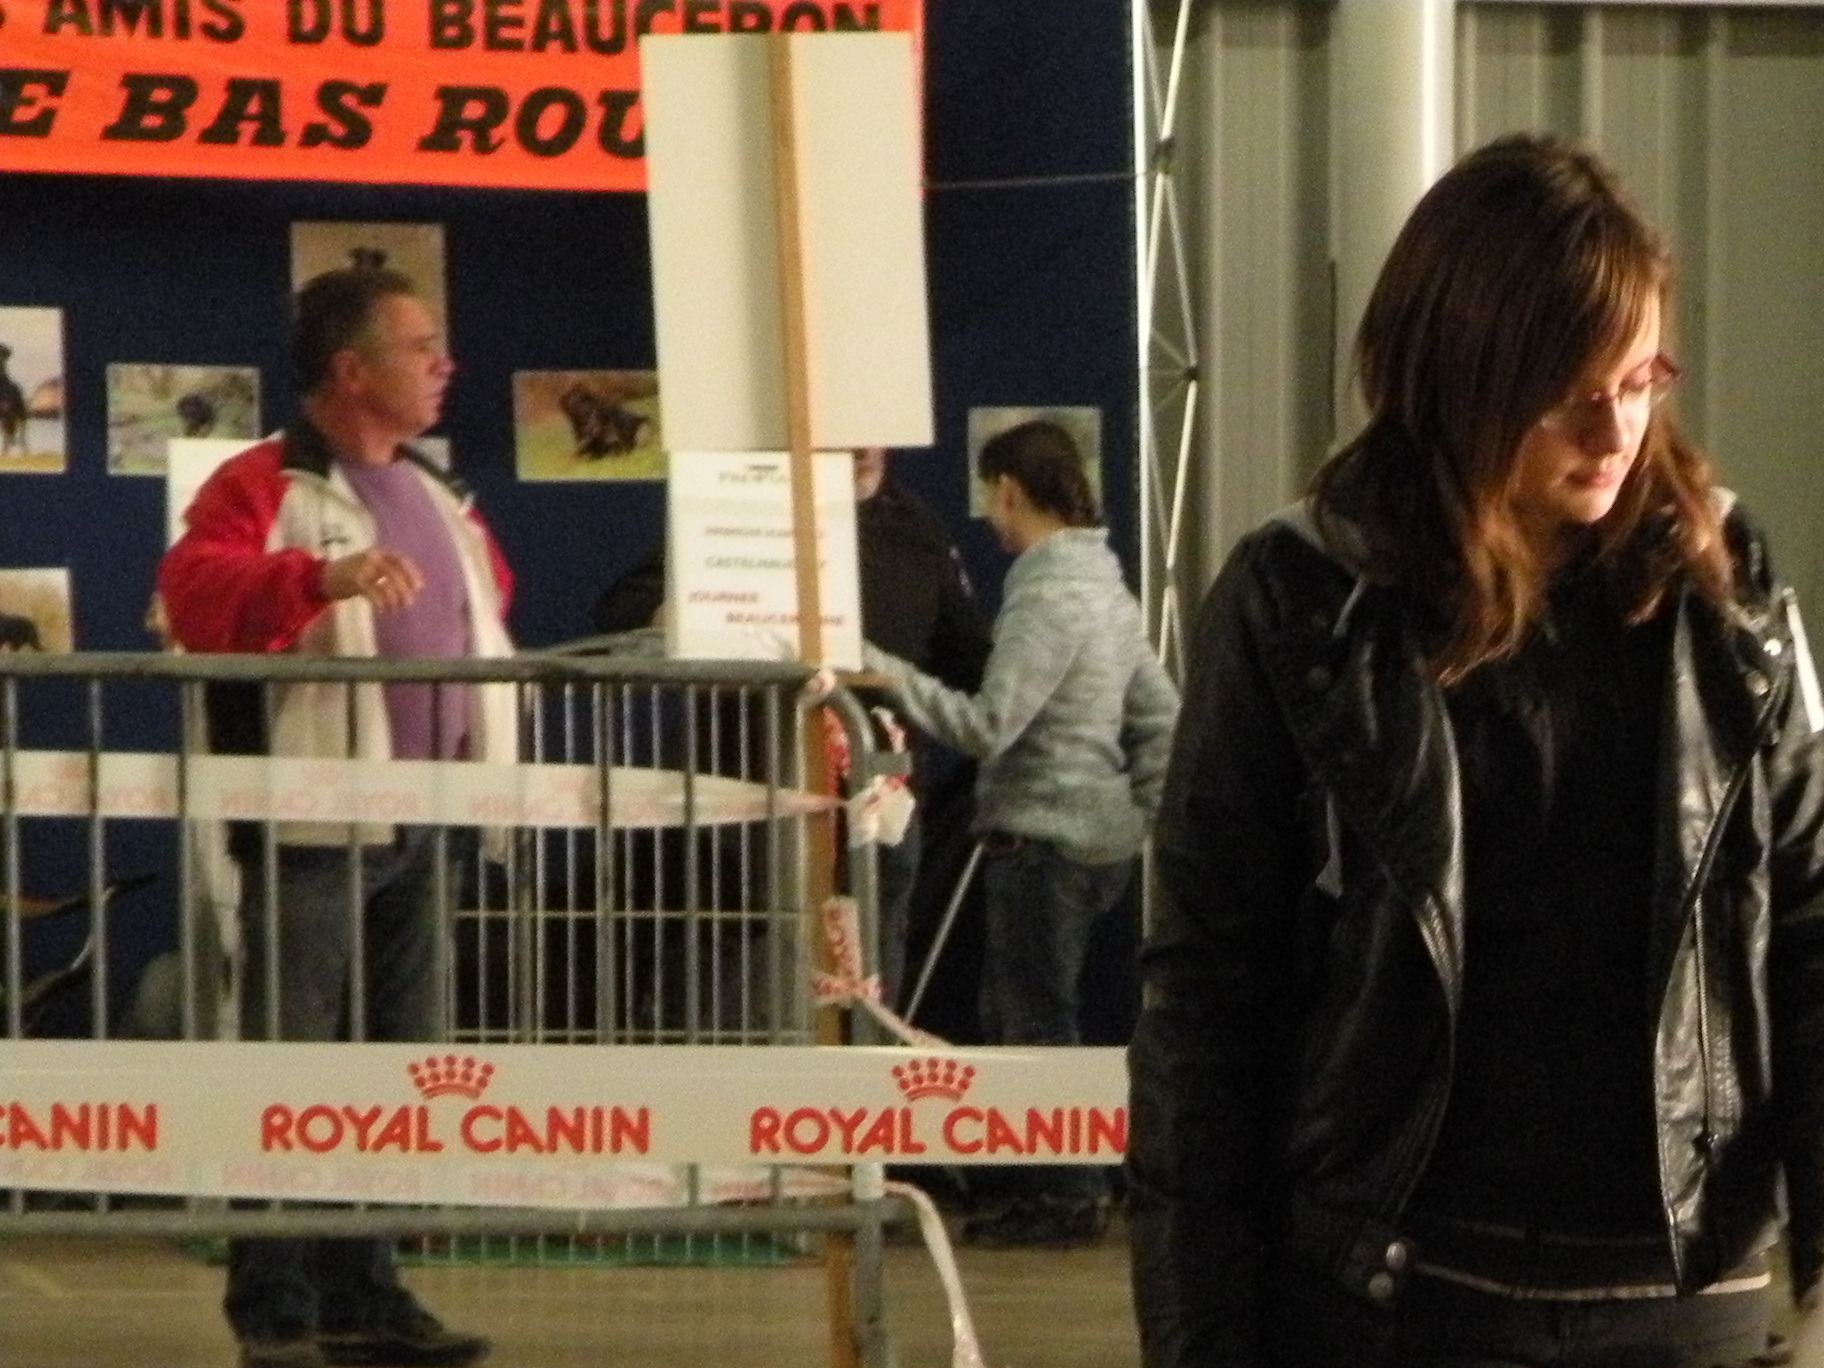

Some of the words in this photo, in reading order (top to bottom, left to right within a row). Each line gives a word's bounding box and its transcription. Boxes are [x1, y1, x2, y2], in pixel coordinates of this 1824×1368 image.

[286, 0, 386, 46] DU
[103, 72, 388, 149] BAS
[0, 1102, 158, 1151] ANIN
[261, 1103, 443, 1153] ROYAL
[460, 1104, 650, 1154] CANIN
[750, 1106, 926, 1154] ROYAL
[943, 1107, 1128, 1155] CANIN
